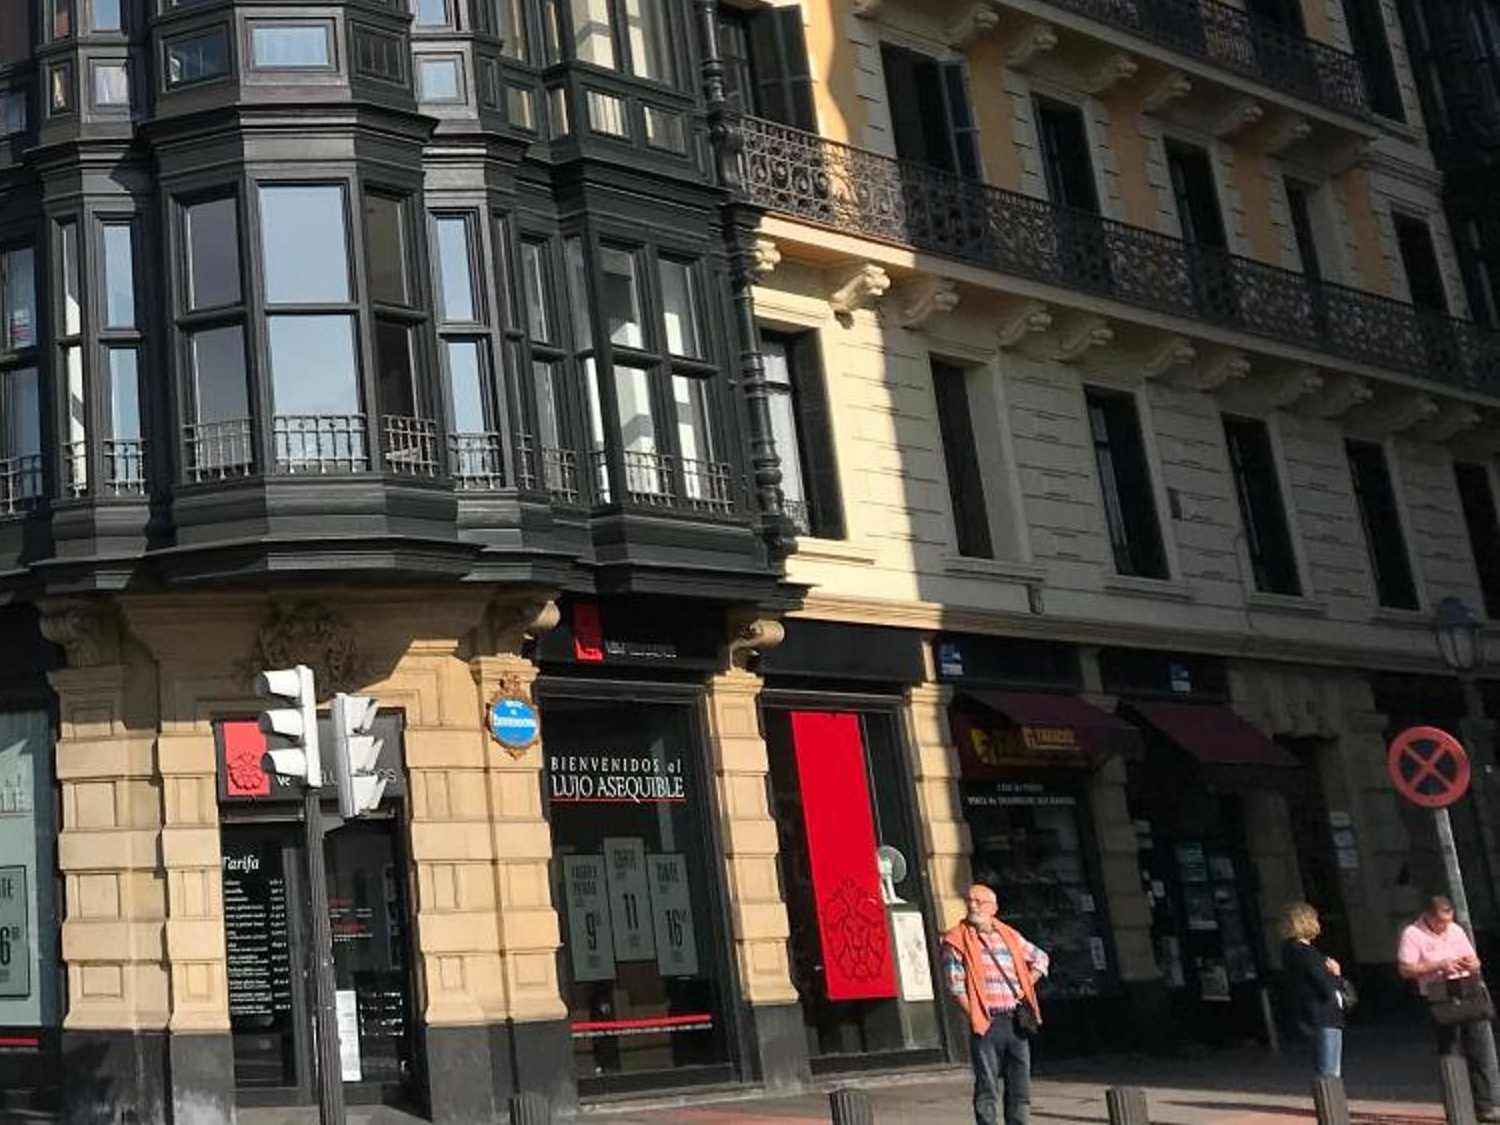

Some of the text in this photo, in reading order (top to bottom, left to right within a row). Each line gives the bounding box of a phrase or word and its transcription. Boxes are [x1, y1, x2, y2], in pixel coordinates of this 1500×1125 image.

[550, 756, 681, 773] BIENVENIDOS al
[551, 774, 685, 803] LUJO ASEQUIBLE
[223, 854, 259, 874] Tarifa
[623, 893, 639, 930] 11
